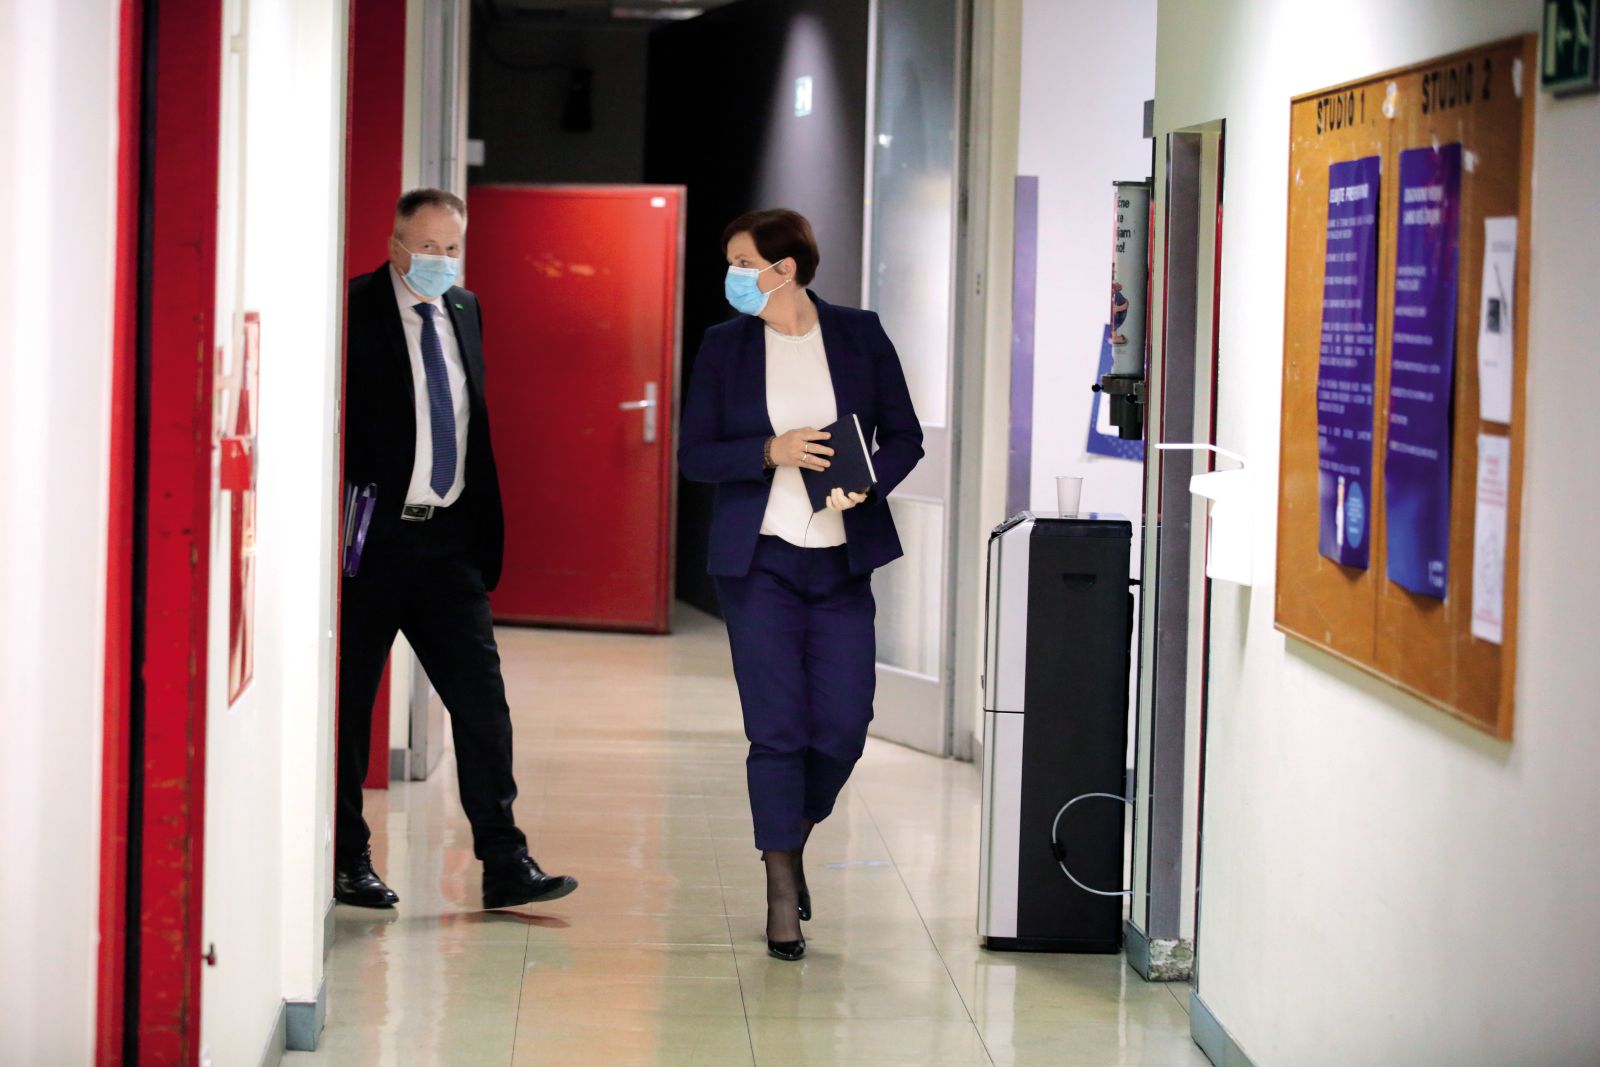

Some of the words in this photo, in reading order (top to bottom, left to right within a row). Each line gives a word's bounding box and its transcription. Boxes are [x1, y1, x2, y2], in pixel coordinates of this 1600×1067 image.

[1317, 90, 1355, 135] STUDIO
[1361, 89, 1365, 125] 1
[1422, 63, 1473, 115] STUDIO
[1482, 57, 1492, 101] 2
